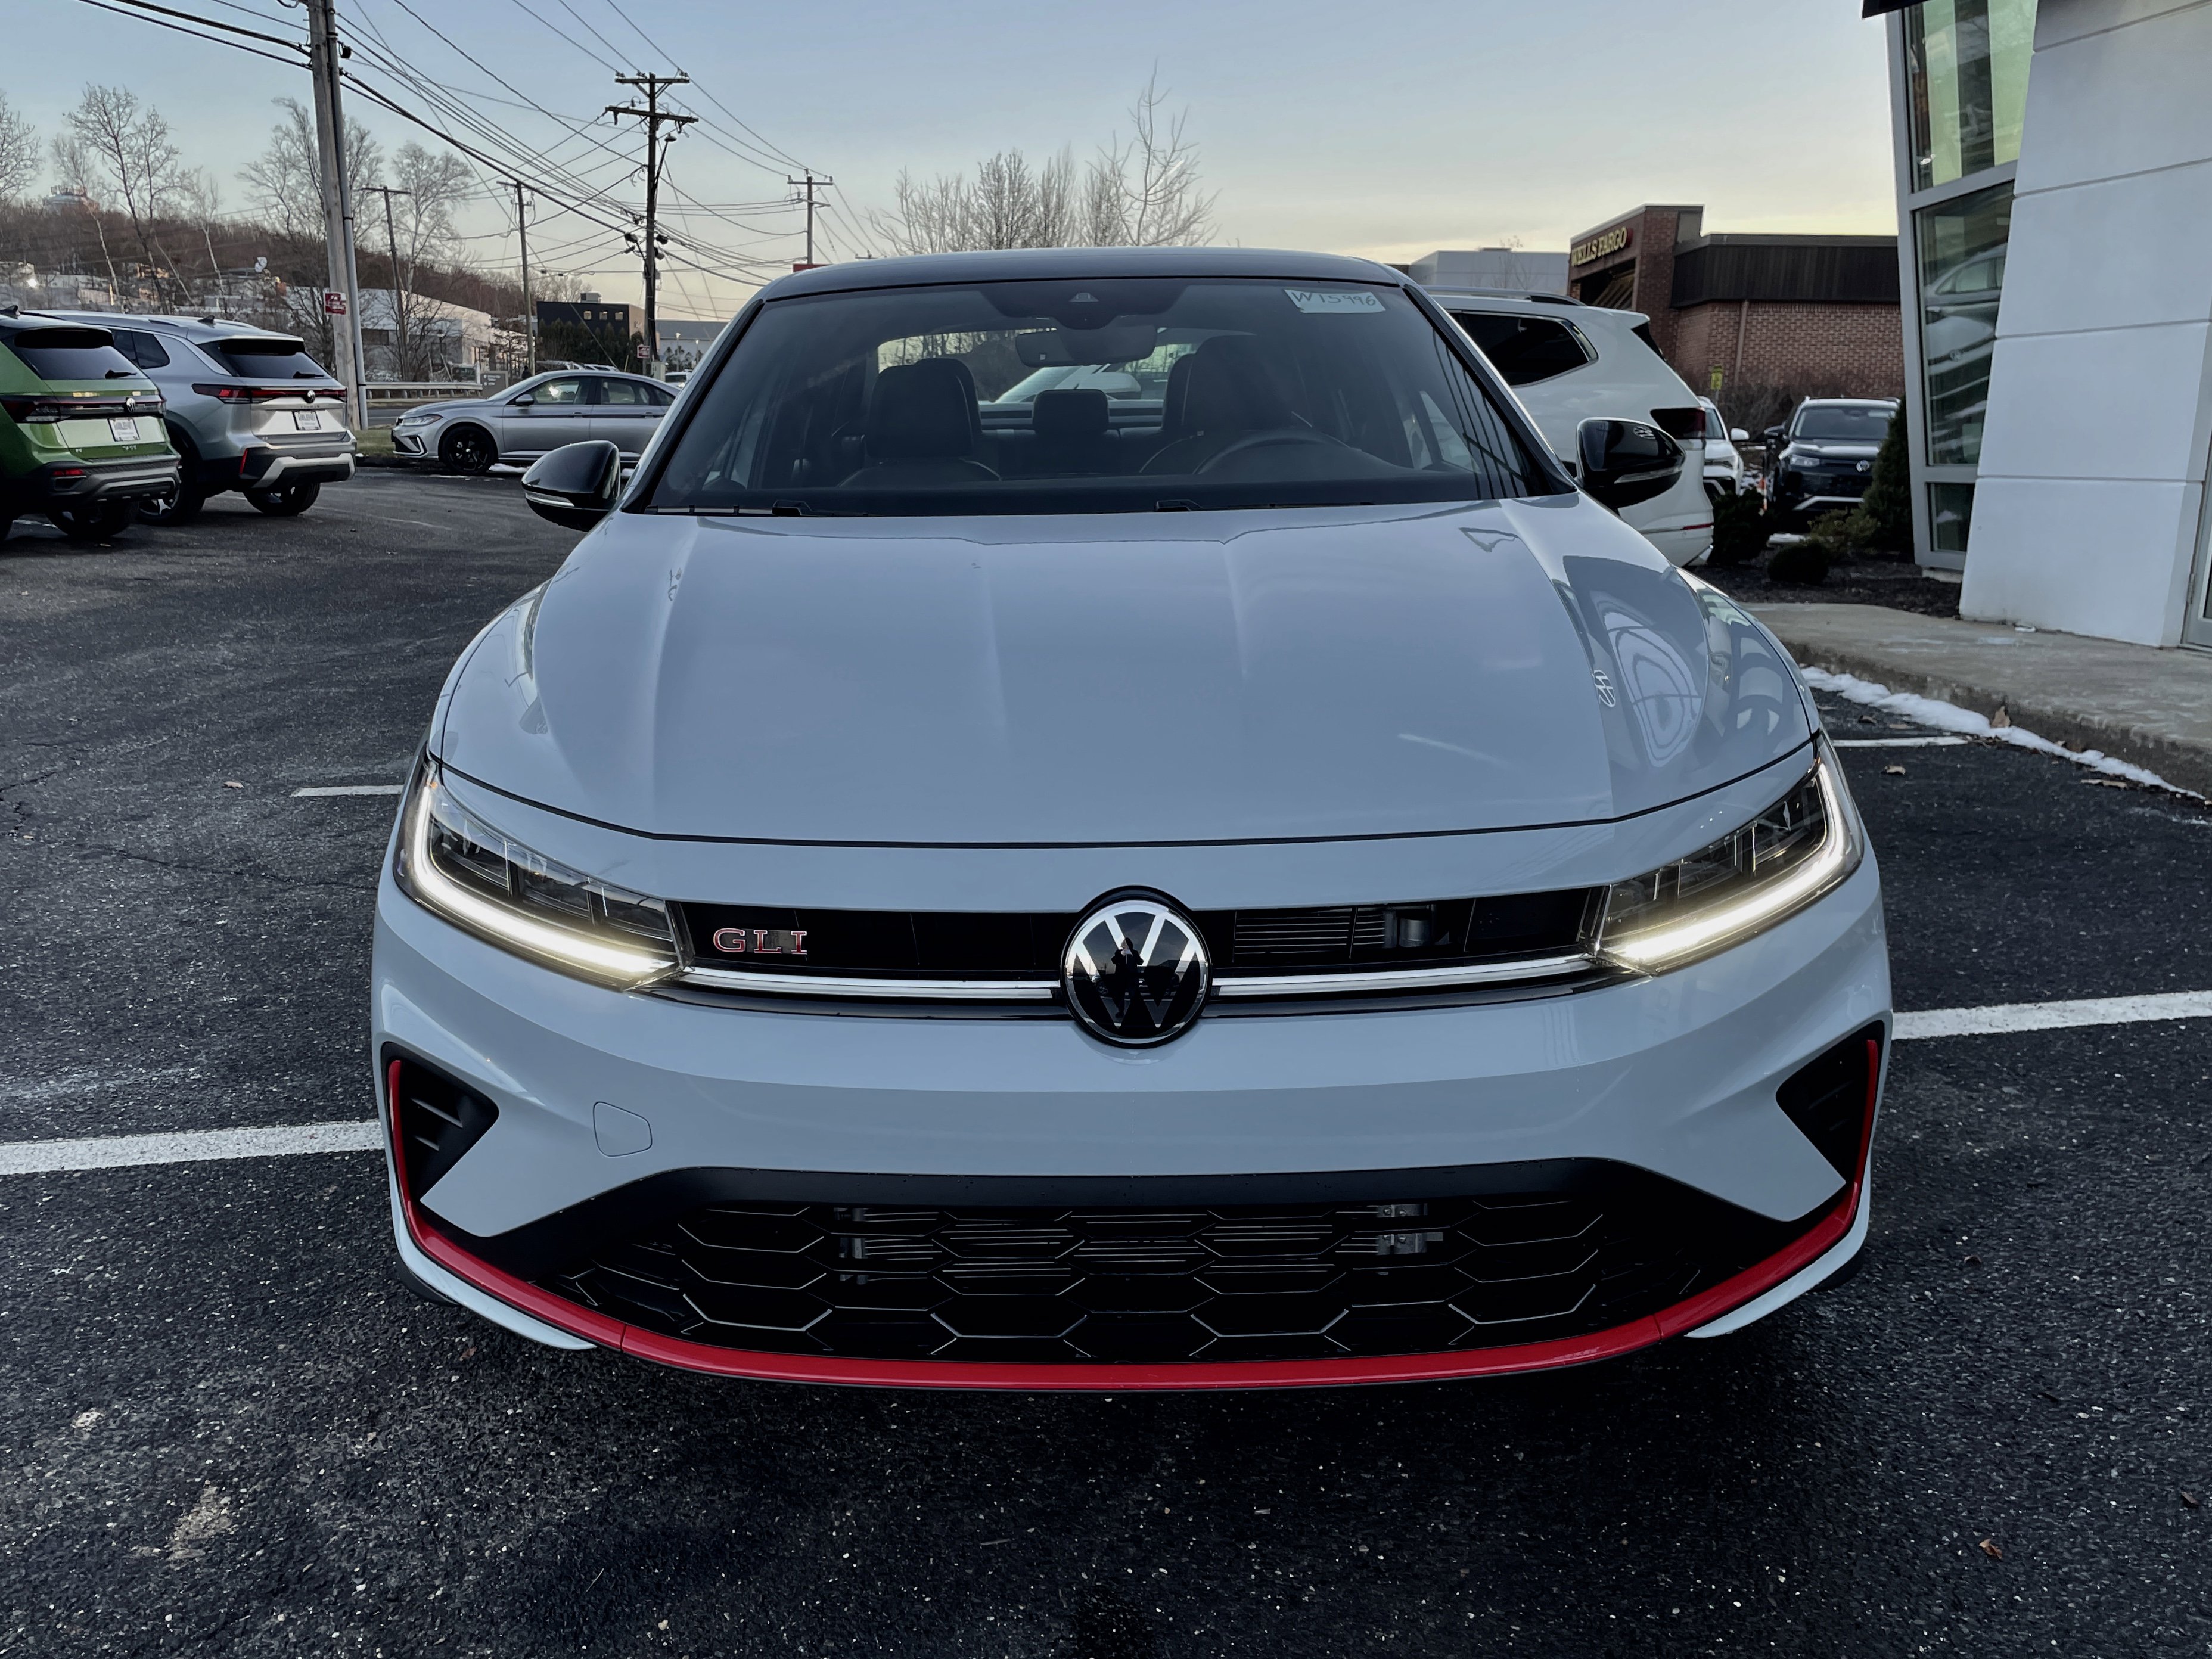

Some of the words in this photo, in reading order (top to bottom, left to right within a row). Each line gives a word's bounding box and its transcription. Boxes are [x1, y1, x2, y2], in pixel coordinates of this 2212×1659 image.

[1571, 239, 1598, 267] WELLS
[1598, 226, 1627, 257] FARGO
[1291, 291, 1376, 306] W15996
[713, 928, 807, 955] GLI
[1065, 902, 1207, 1040] VW
